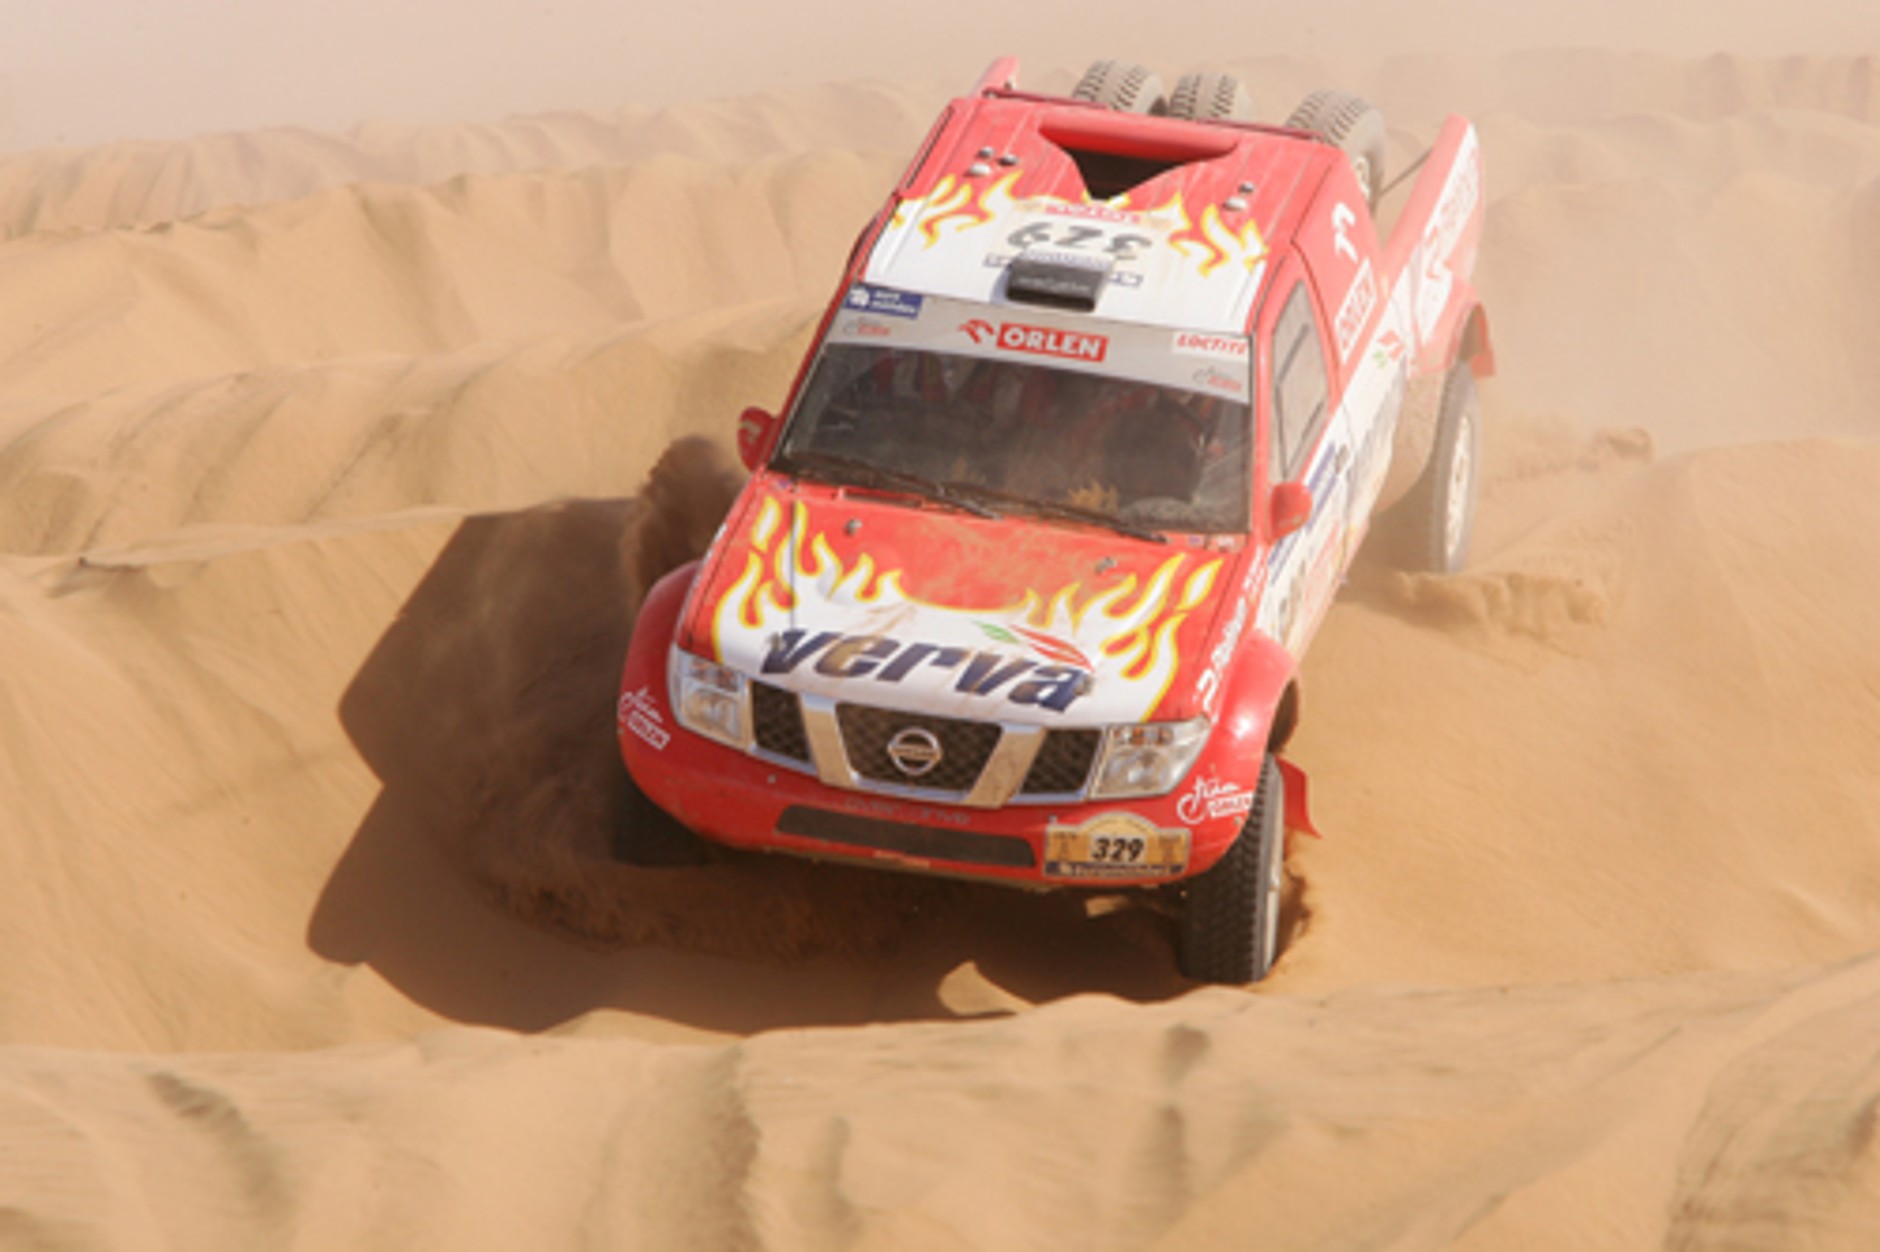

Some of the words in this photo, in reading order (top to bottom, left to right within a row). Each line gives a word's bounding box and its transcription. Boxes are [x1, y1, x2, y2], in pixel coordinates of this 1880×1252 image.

[1003, 326, 1101, 360] ORLEN
[760, 629, 1090, 714] verva
[1092, 837, 1145, 862] 329
